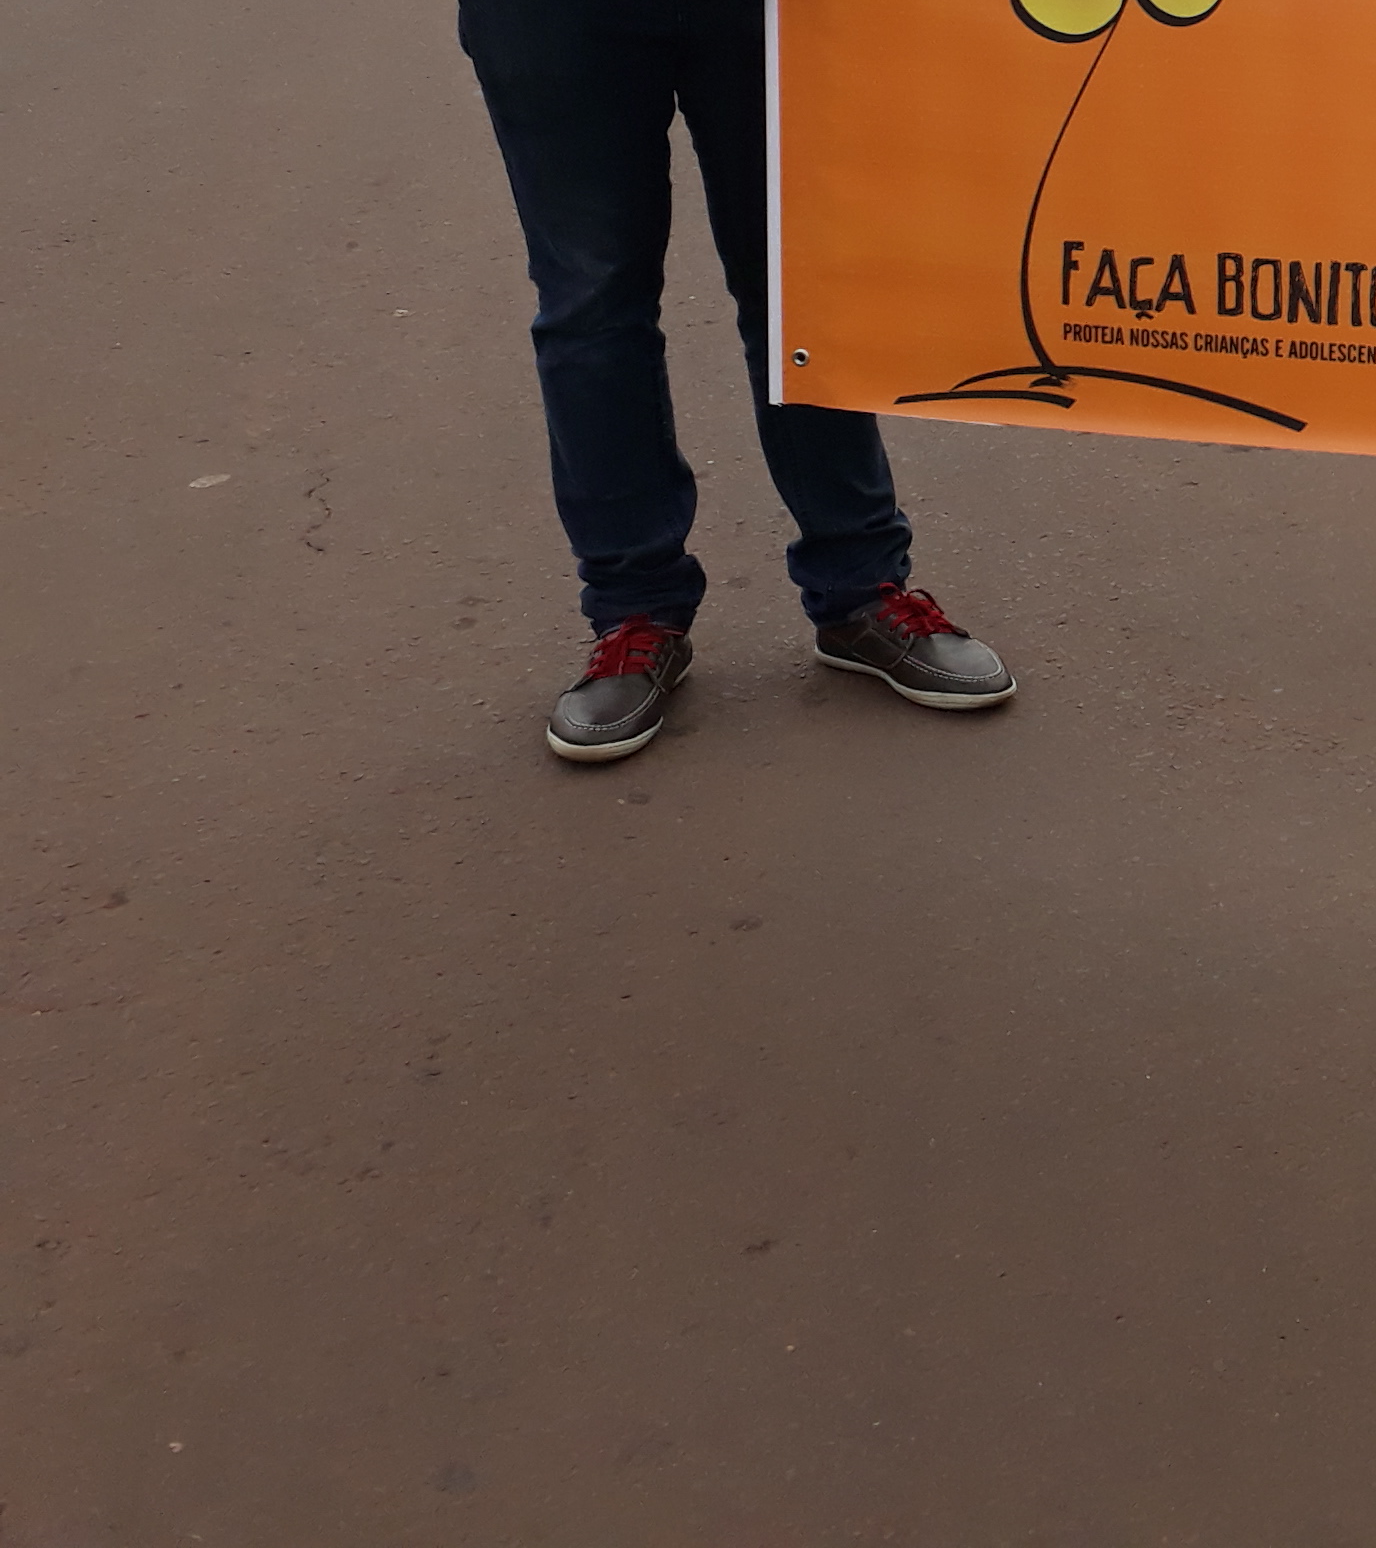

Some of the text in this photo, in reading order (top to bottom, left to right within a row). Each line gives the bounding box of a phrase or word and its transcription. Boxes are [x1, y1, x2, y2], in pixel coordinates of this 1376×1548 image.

[1062, 241, 1196, 320] FAÇA
[1064, 323, 1124, 345] PROTEJA
[1130, 328, 1188, 350] NOSSAS
[1194, 333, 1269, 358] CRIANÇAS
[1275, 340, 1283, 357] E
